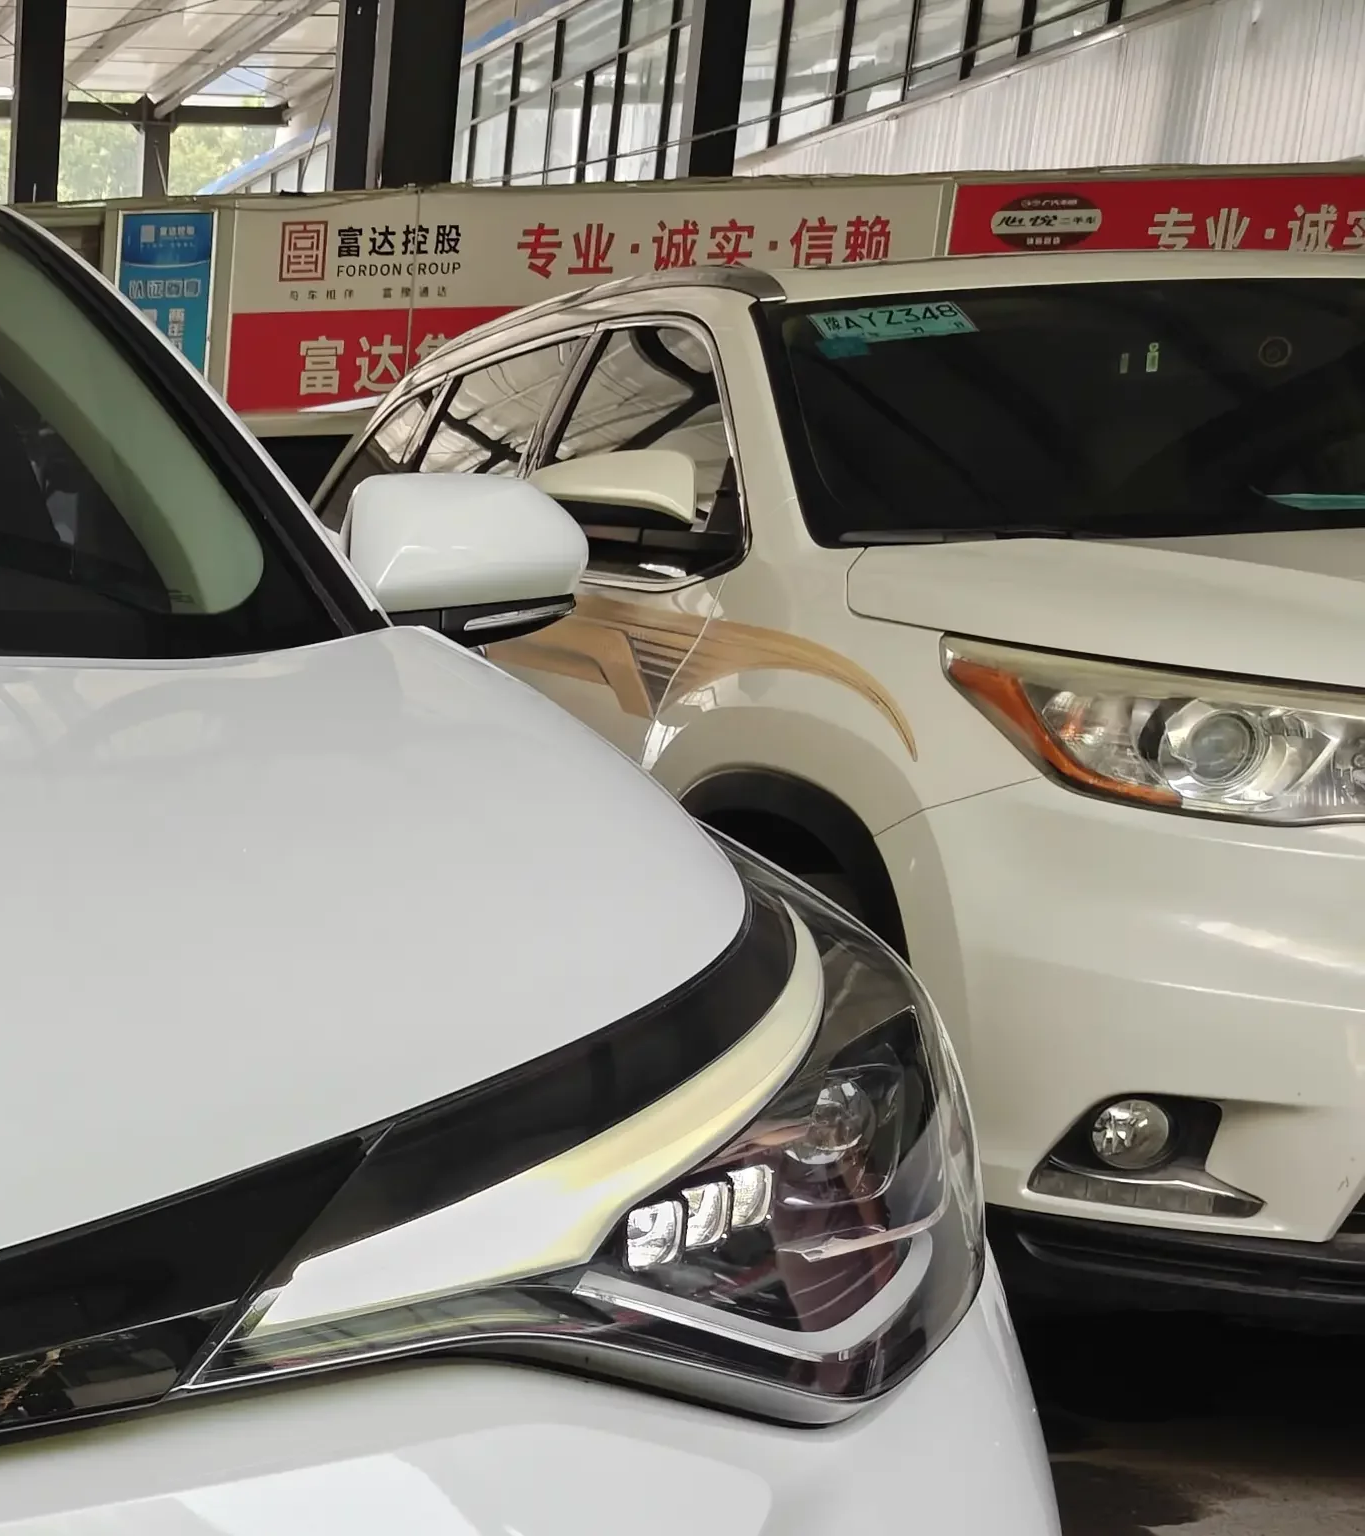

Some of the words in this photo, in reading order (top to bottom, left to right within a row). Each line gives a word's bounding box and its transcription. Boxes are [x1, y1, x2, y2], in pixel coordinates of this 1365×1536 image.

[338, 225, 461, 258] 富达控股
[517, 215, 891, 279] 专业·诚实·信赖
[337, 263, 402, 278] FORDON
[407, 262, 461, 276] GROUP
